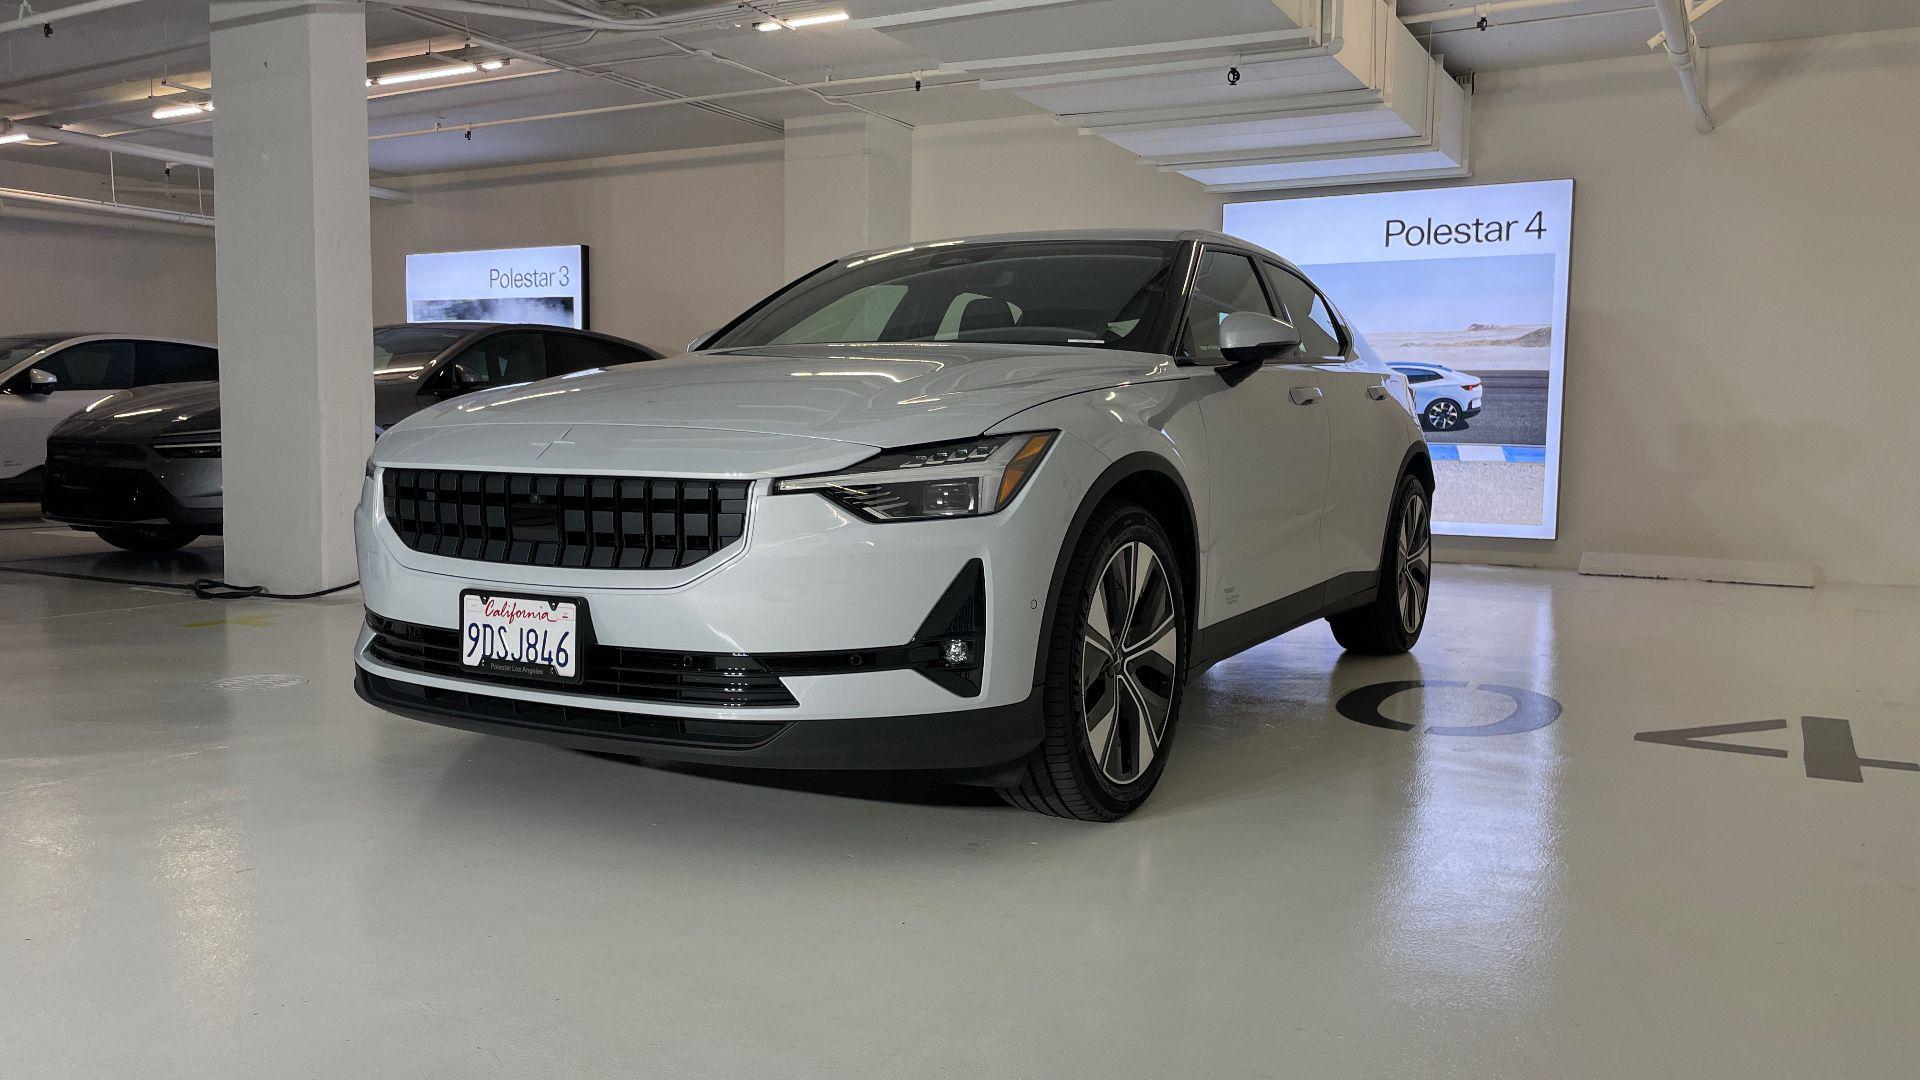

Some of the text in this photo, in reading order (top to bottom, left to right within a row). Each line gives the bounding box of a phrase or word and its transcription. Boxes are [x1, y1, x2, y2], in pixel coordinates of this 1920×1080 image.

[1385, 210, 1547, 248] Polestar 4
[489, 265, 570, 289] Polestar 3
[485, 600, 557, 624] California
[467, 623, 570, 668] 9DSJ846
